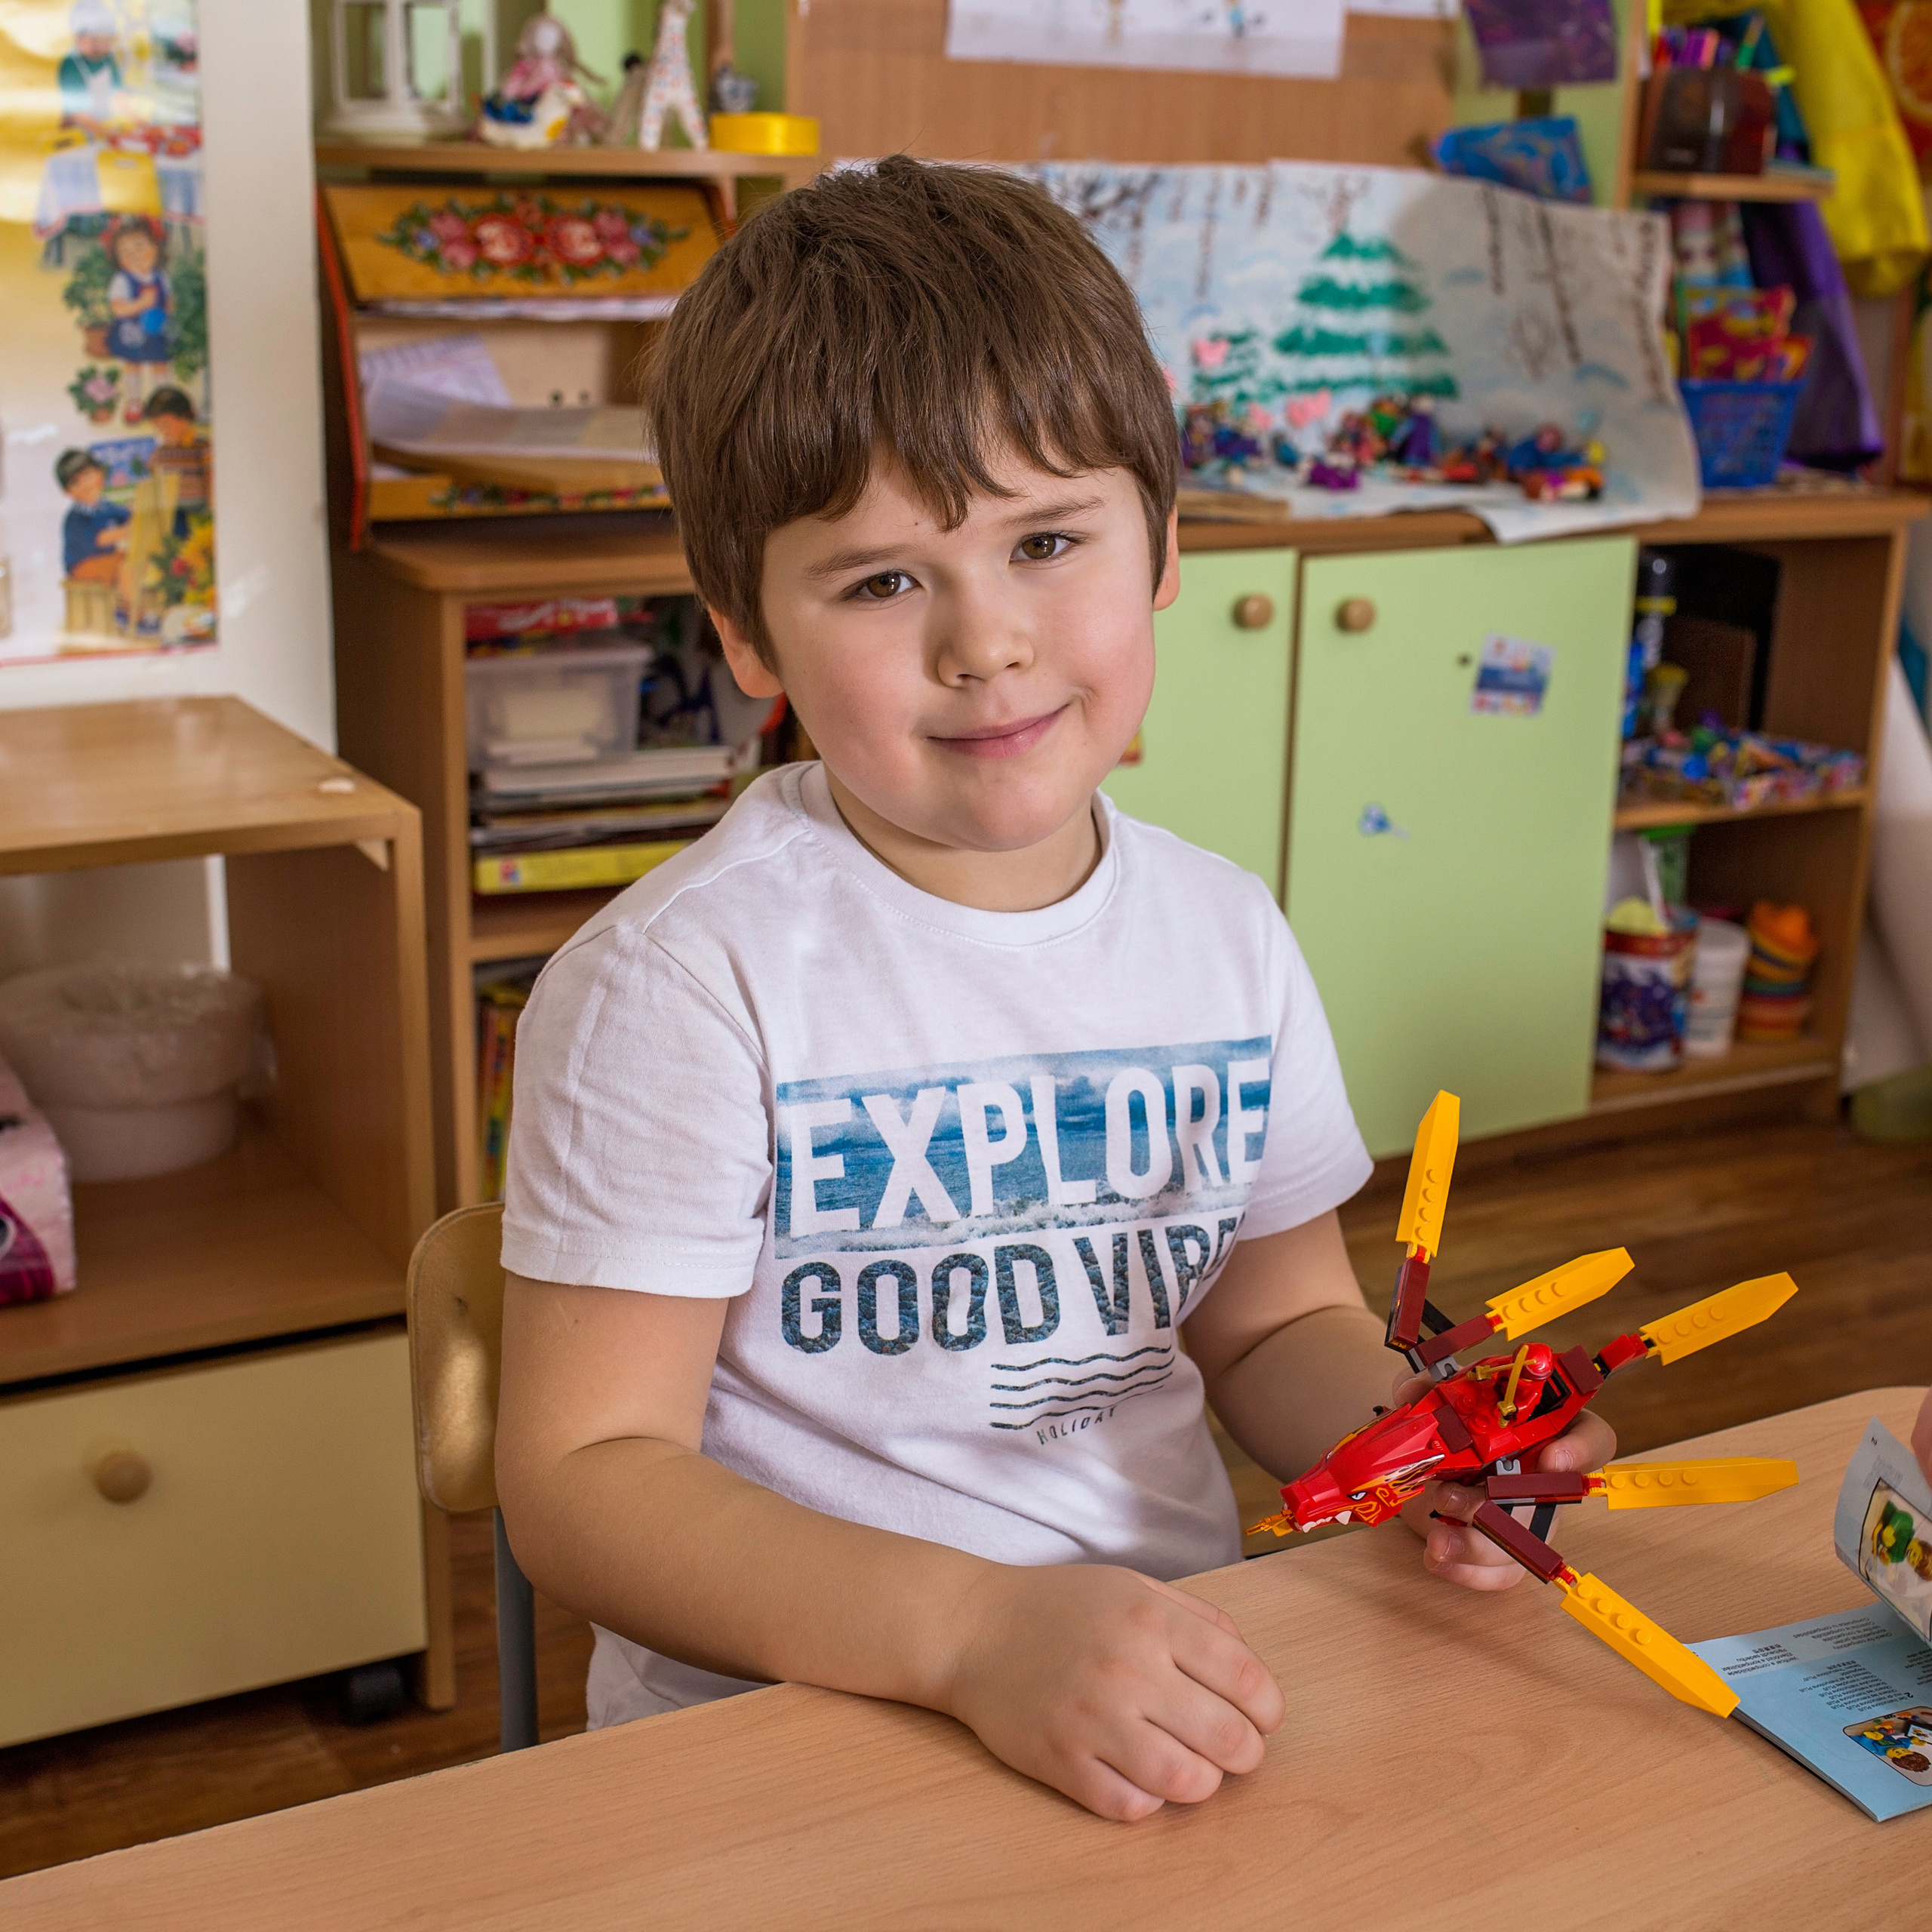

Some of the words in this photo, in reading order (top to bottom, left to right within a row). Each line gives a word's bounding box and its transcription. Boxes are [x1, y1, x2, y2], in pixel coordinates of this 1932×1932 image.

[790, 1057, 1269, 1239] EXPLORE
[782, 1242, 1060, 1356] GOOD
[1036, 1405, 1117, 1445] HOLIDAY
